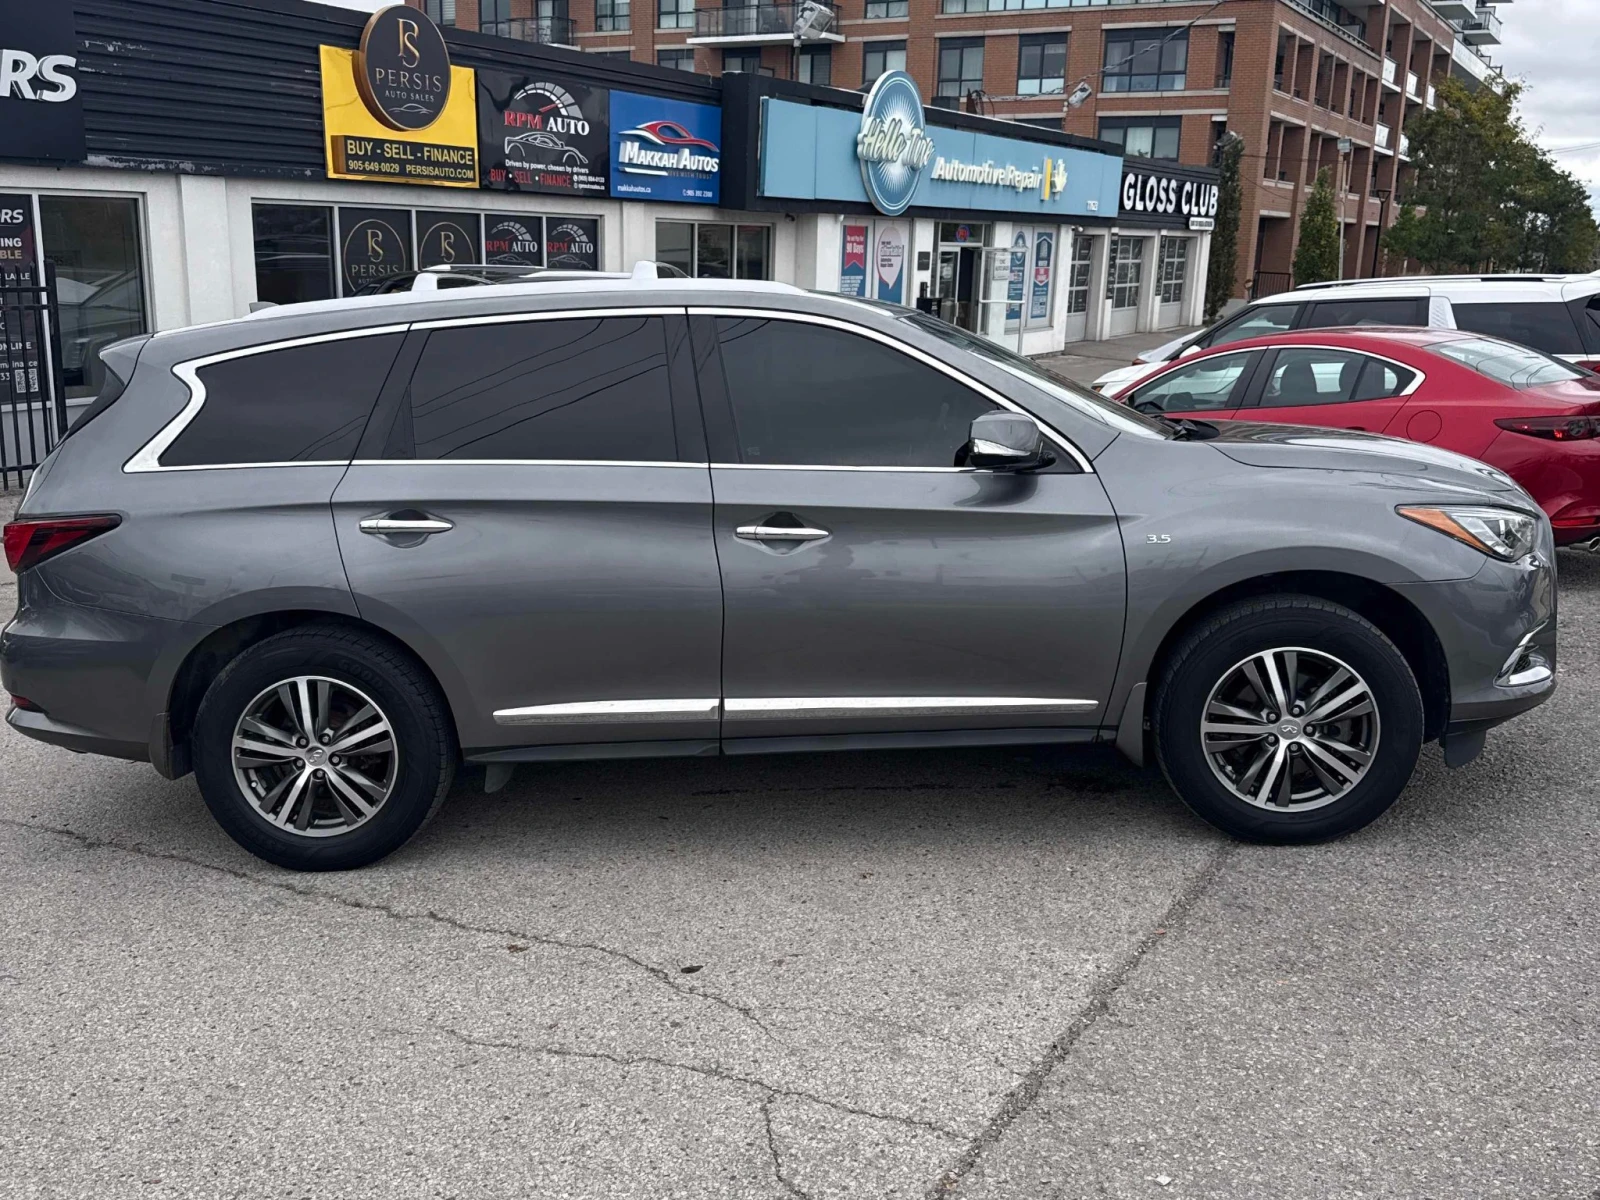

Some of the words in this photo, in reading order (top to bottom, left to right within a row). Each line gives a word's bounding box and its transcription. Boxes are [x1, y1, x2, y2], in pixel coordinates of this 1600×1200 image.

[375, 68, 442, 93] PERSIS
[385, 90, 407, 100] AUTO
[410, 93, 435, 103] SALES
[503, 110, 543, 130] RPM
[547, 116, 590, 136] AUTO
[860, 117, 907, 162] Hello
[347, 140, 373, 156] BUY
[383, 143, 414, 160] SELL
[423, 147, 473, 164] FINANCE
[622, 141, 678, 168] MAKKAH
[679, 148, 719, 172] AUTOS
[348, 160, 400, 173] 905-649-0029
[405, 164, 474, 179] PERSISAUTO.COM
[505, 159, 522, 168] Driven
[523, 160, 530, 170] by
[565, 165, 572, 174] by
[572, 166, 589, 174] drivers
[933, 157, 1007, 185] Automotive
[1006, 165, 1043, 192] Repair
[490, 168, 506, 181] BUY
[514, 170, 532, 184] SELL
[540, 173, 571, 188] FINANCE
[1123, 173, 1177, 214] GLOSS
[1181, 181, 1219, 217] CLUB
[485, 240, 509, 252] RPM
[511, 241, 538, 253] AUTO
[547, 241, 568, 253] RPM
[569, 242, 594, 254] AUTO
[351, 264, 400, 277] PERSIS
[1147, 534, 1171, 544] 3.5
